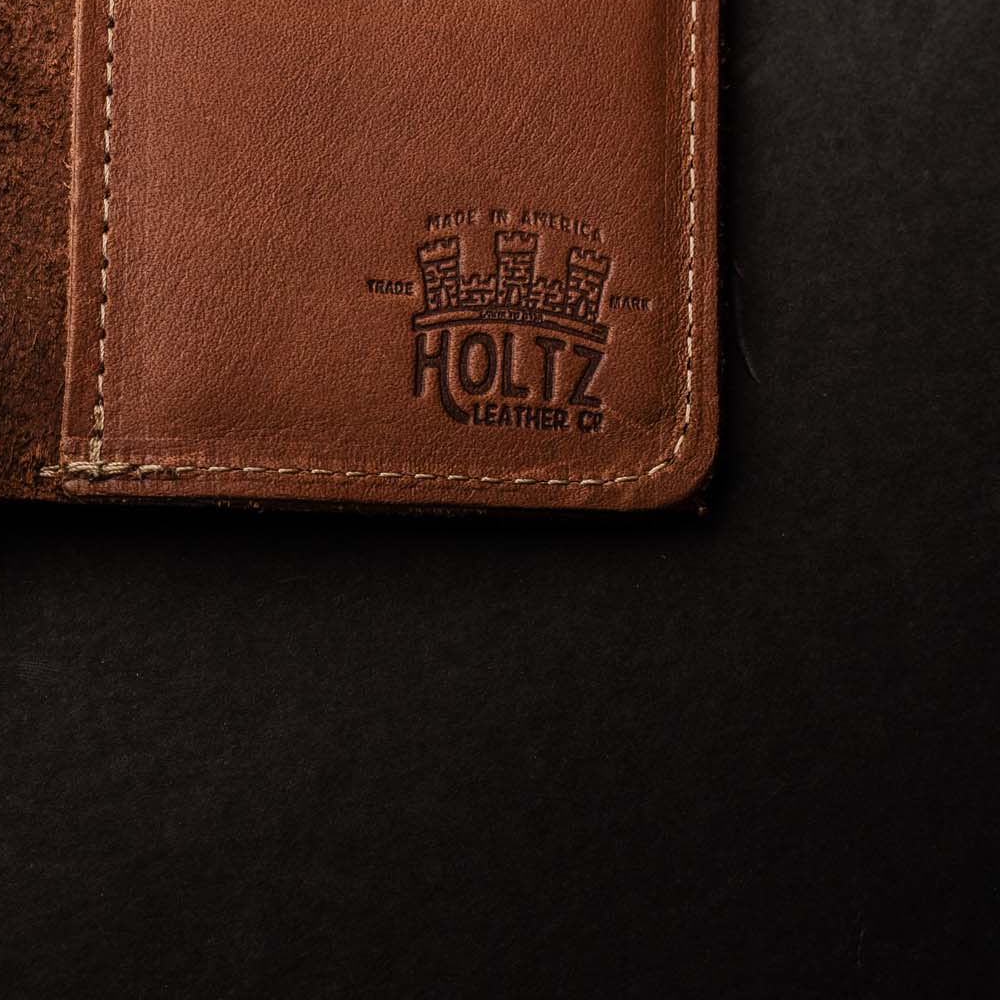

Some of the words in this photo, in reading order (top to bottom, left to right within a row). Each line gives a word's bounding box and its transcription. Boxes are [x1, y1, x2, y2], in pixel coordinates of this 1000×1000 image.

[427, 210, 480, 231] MADE
[490, 209, 508, 225] IN
[521, 210, 603, 242] AMERICA
[366, 279, 416, 296] TRADE
[608, 296, 651, 311] MARK
[412, 330, 605, 425] HOLTZ
[473, 404, 568, 432] LEATHER
